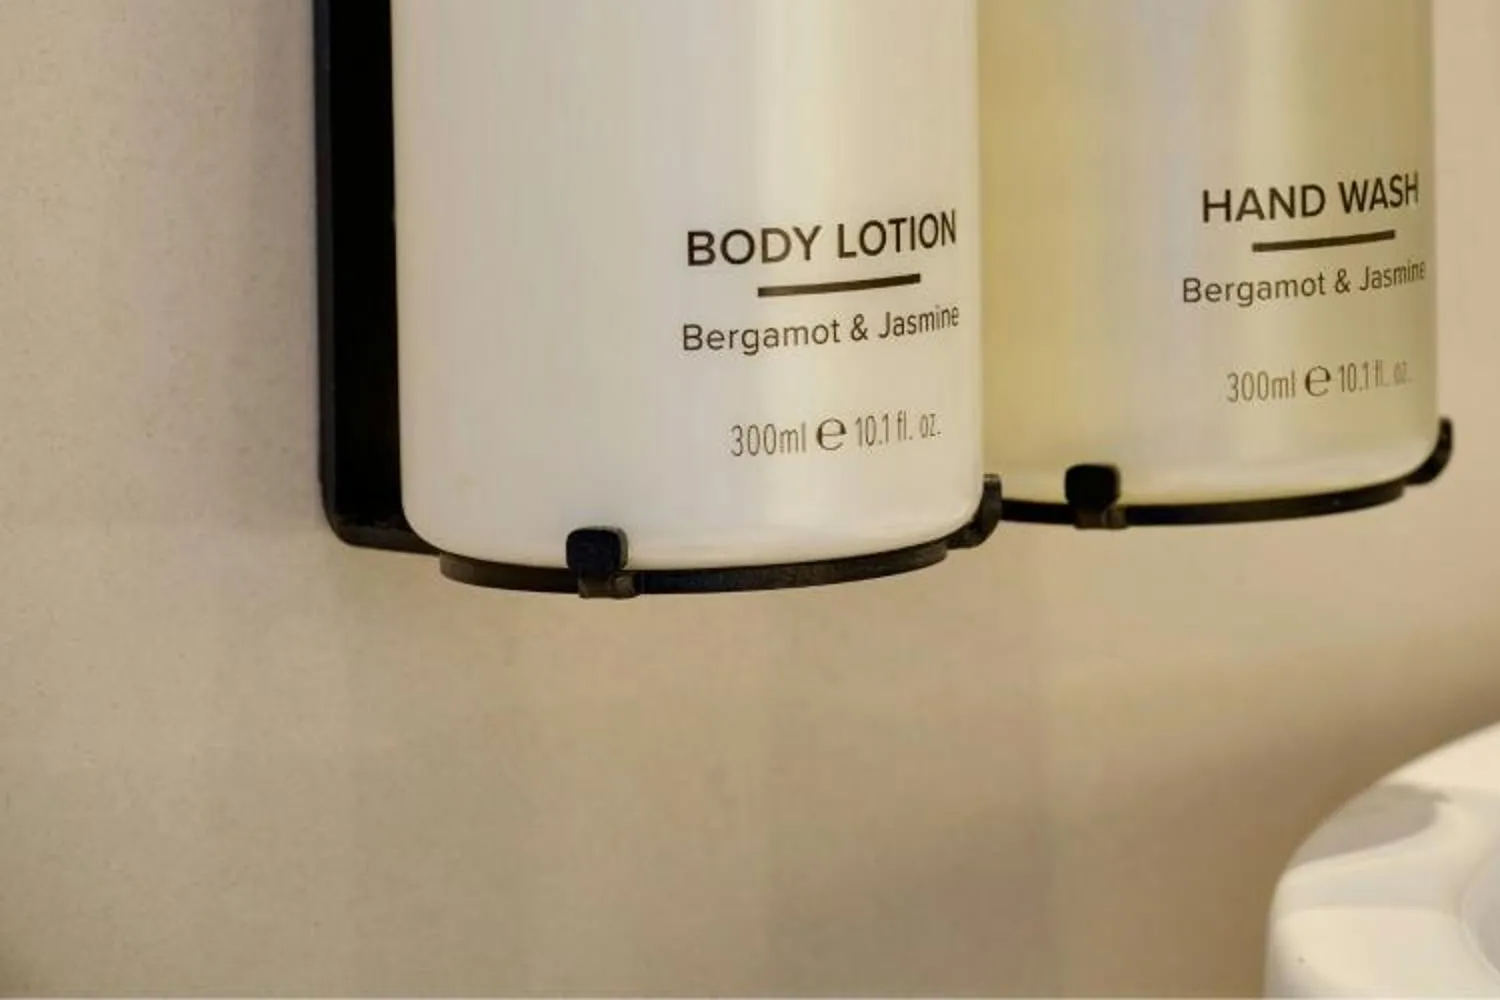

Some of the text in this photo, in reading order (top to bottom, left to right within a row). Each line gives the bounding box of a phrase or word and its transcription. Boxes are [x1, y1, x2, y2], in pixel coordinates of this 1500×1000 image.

[1202, 171, 1419, 223] HAND WASH
[687, 208, 957, 266] BODY LOTION
[1183, 258, 1426, 307] Bergamot & Jasmine
[682, 304, 960, 356] Bergamot & Jasmine
[1226, 368, 1296, 403] 300ml
[1338, 361, 1370, 393] 10.1
[730, 422, 807, 457] 300ml
[854, 412, 890, 447] 10.1
[896, 409, 913, 441] fl.
[919, 412, 942, 439] oz.
